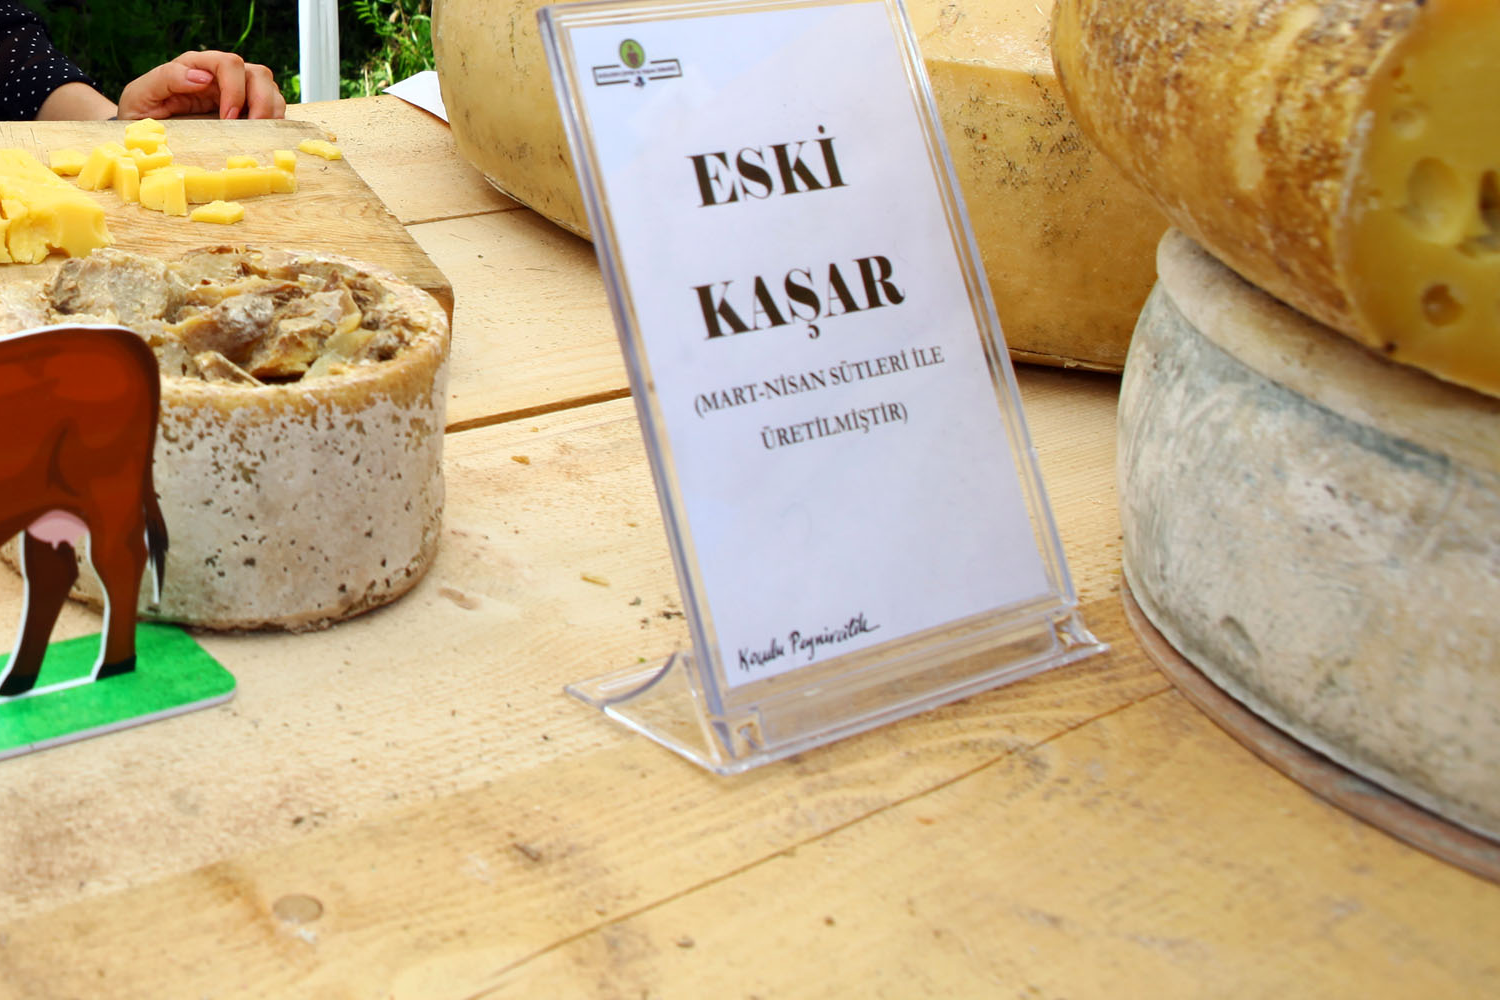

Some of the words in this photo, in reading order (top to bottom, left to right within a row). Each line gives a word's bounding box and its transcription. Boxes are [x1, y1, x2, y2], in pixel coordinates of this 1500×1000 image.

[684, 124, 851, 208] ESKİ
[690, 254, 906, 341] KAŞAR
[694, 369, 827, 419] (MART-NİSAN
[829, 350, 910, 387] SÜTLERİ
[911, 345, 946, 369] İLE
[760, 400, 909, 450] ÜRETİLMİŞTİR)
